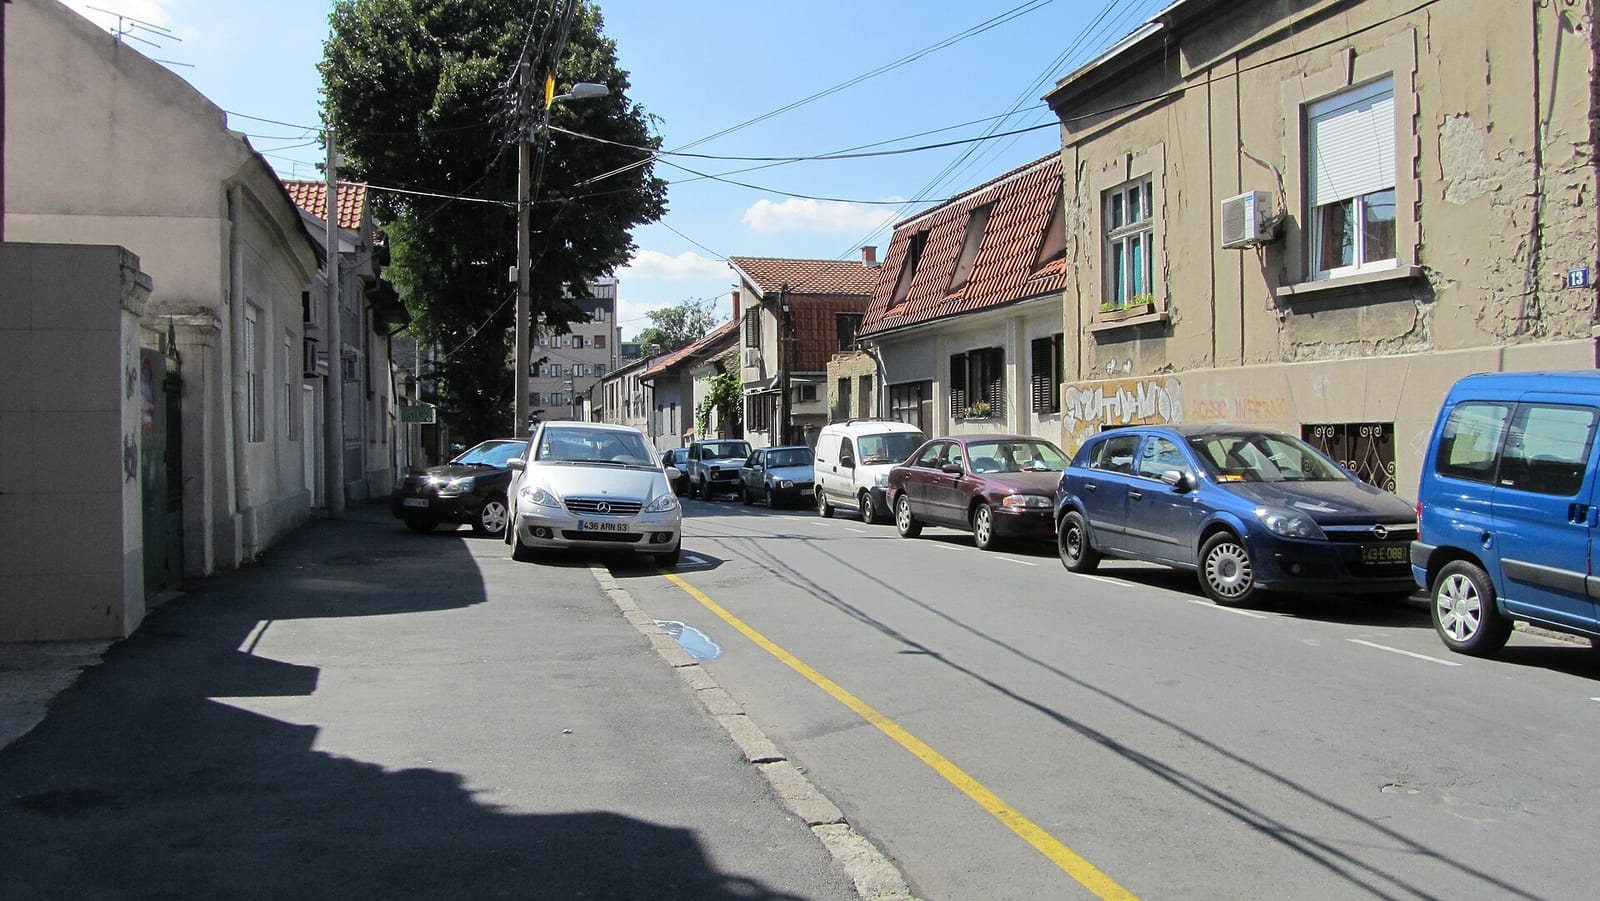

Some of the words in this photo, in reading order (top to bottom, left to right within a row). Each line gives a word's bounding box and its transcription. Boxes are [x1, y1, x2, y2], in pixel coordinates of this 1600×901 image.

[1571, 271, 1583, 286] 13
[583, 522, 599, 531] 436
[600, 523, 616, 532] ARN
[616, 523, 628, 532] 93
